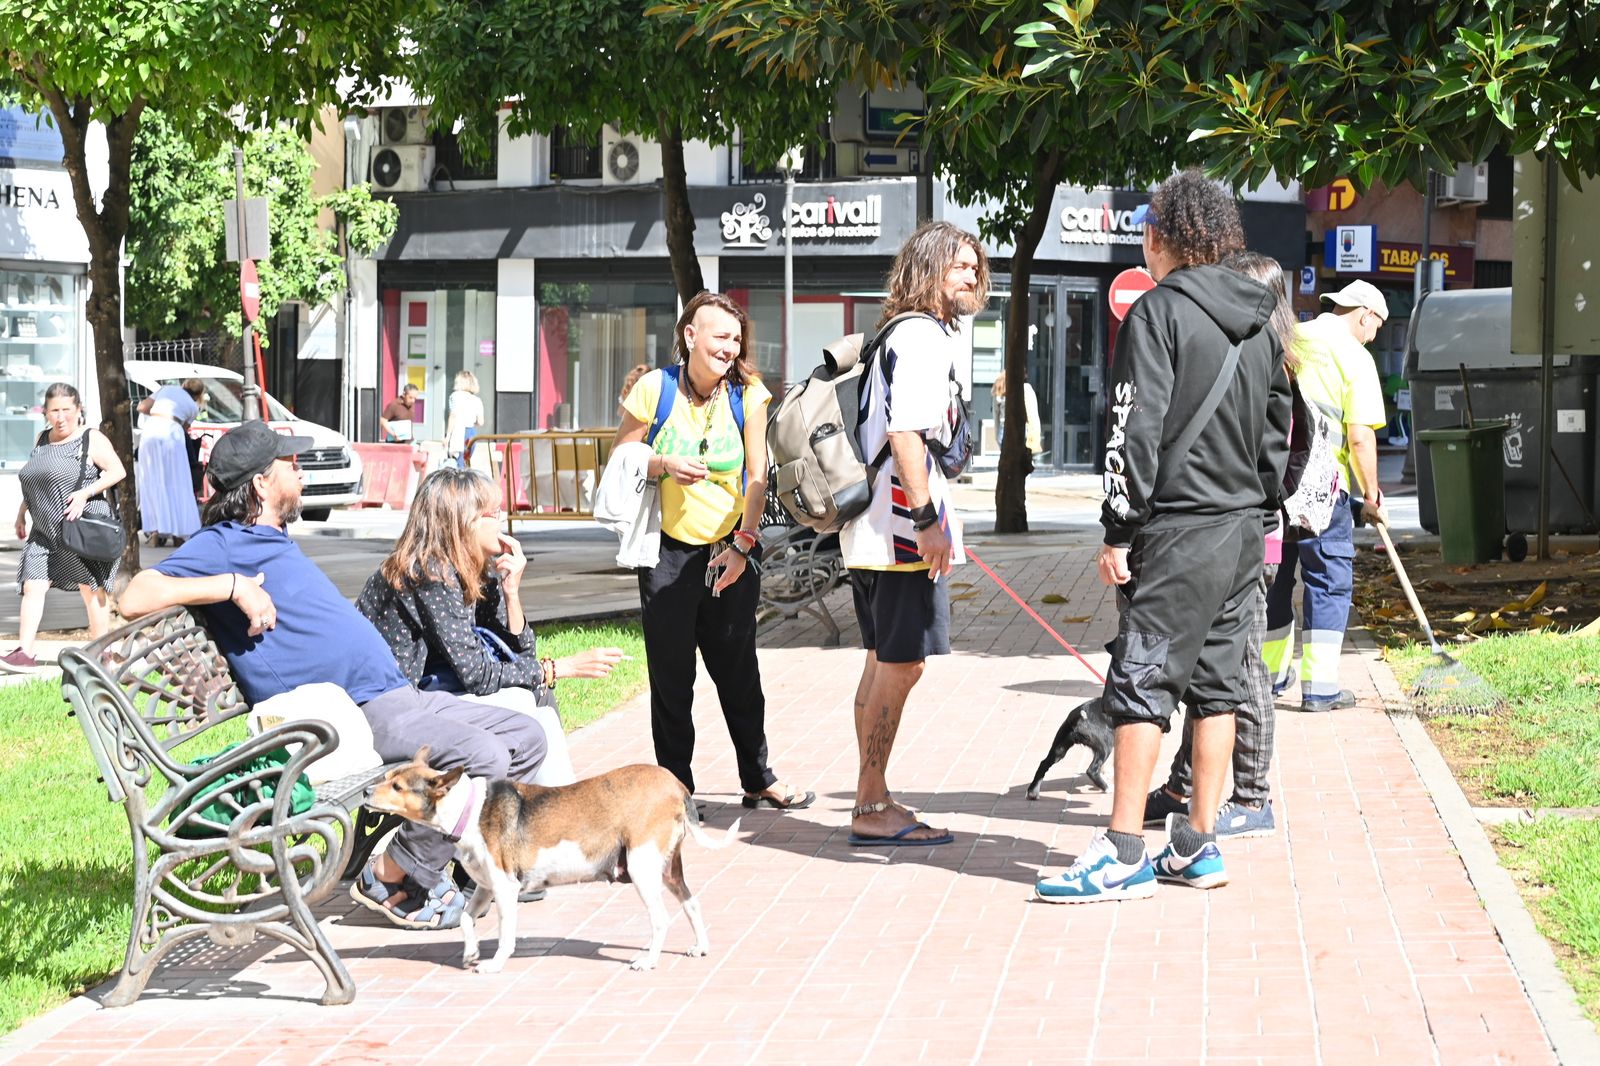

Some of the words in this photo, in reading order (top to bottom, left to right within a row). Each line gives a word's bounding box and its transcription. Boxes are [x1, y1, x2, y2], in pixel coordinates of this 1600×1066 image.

[782, 194, 881, 225] carivall
[1060, 202, 1144, 231] cariva
[1108, 233, 1144, 245] mader
[1381, 248, 1449, 268] TABAOS
